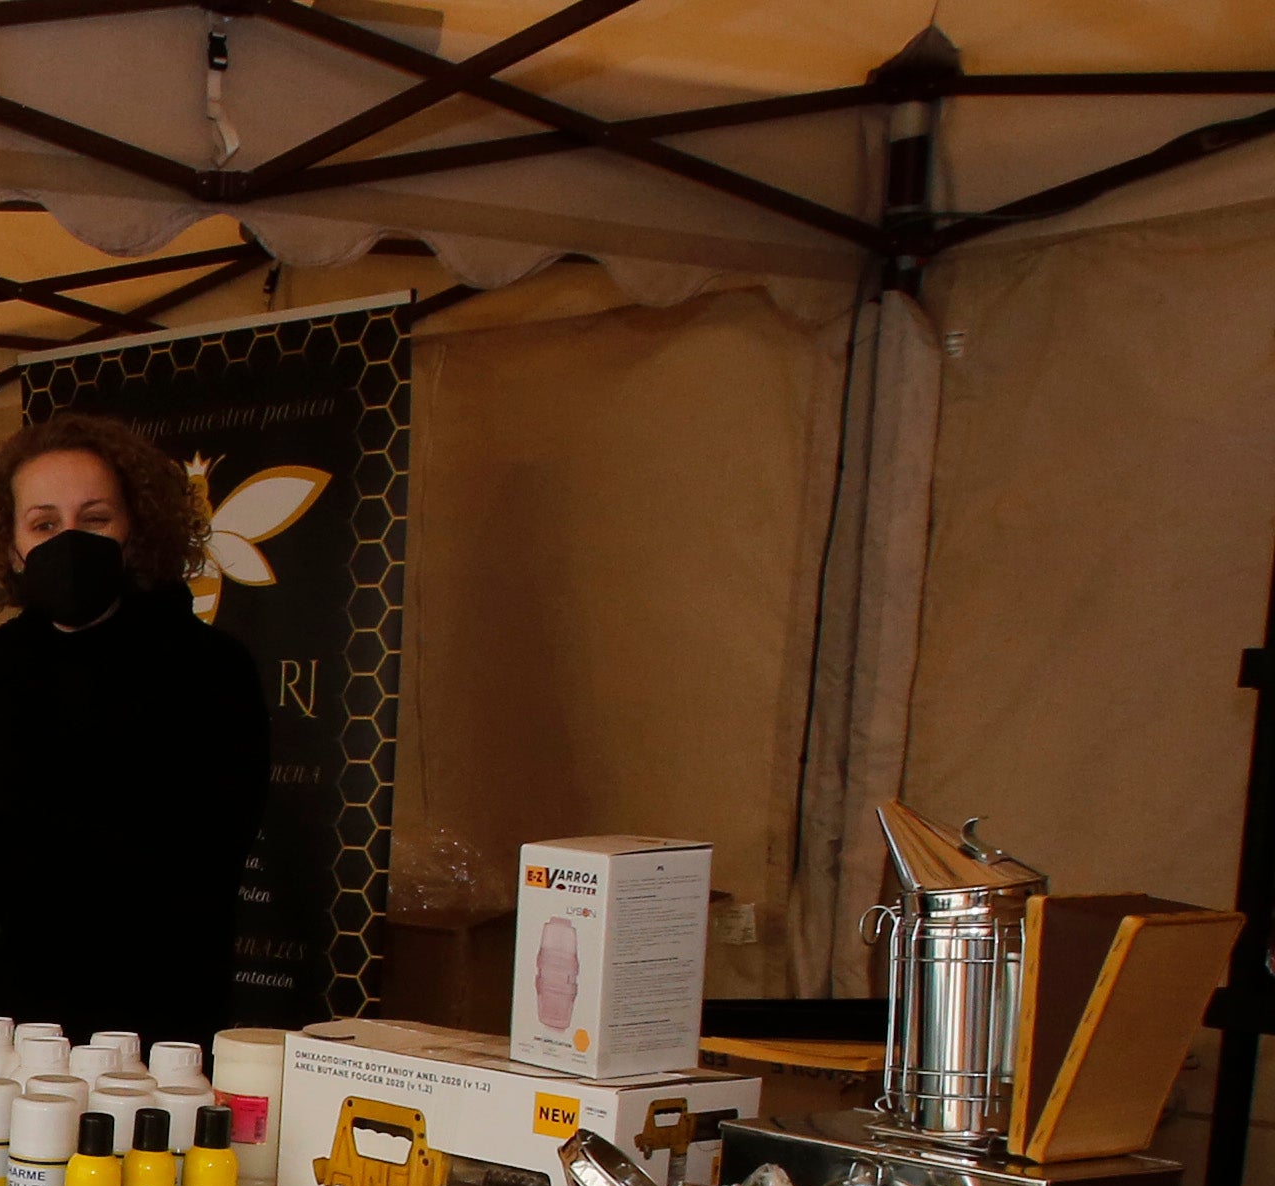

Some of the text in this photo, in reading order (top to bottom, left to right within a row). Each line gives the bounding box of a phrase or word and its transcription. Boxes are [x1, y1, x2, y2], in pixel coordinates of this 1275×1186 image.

[130, 416, 173, 444] bajo,
[178, 405, 255, 434] nuestra
[279, 657, 319, 717] RJ
[526, 866, 599, 888] E-Z VARROA
[568, 885, 597, 897] TESTER
[565, 906, 598, 918] LYSON
[234, 968, 294, 990] entación
[294, 1061, 316, 1074] ANEL
[316, 1065, 350, 1079] BUTANE
[350, 1071, 385, 1086] FOGGER
[385, 1077, 406, 1089] 2020
[440, 1075, 463, 1087] 2020
[539, 1105, 577, 1126] NEW
